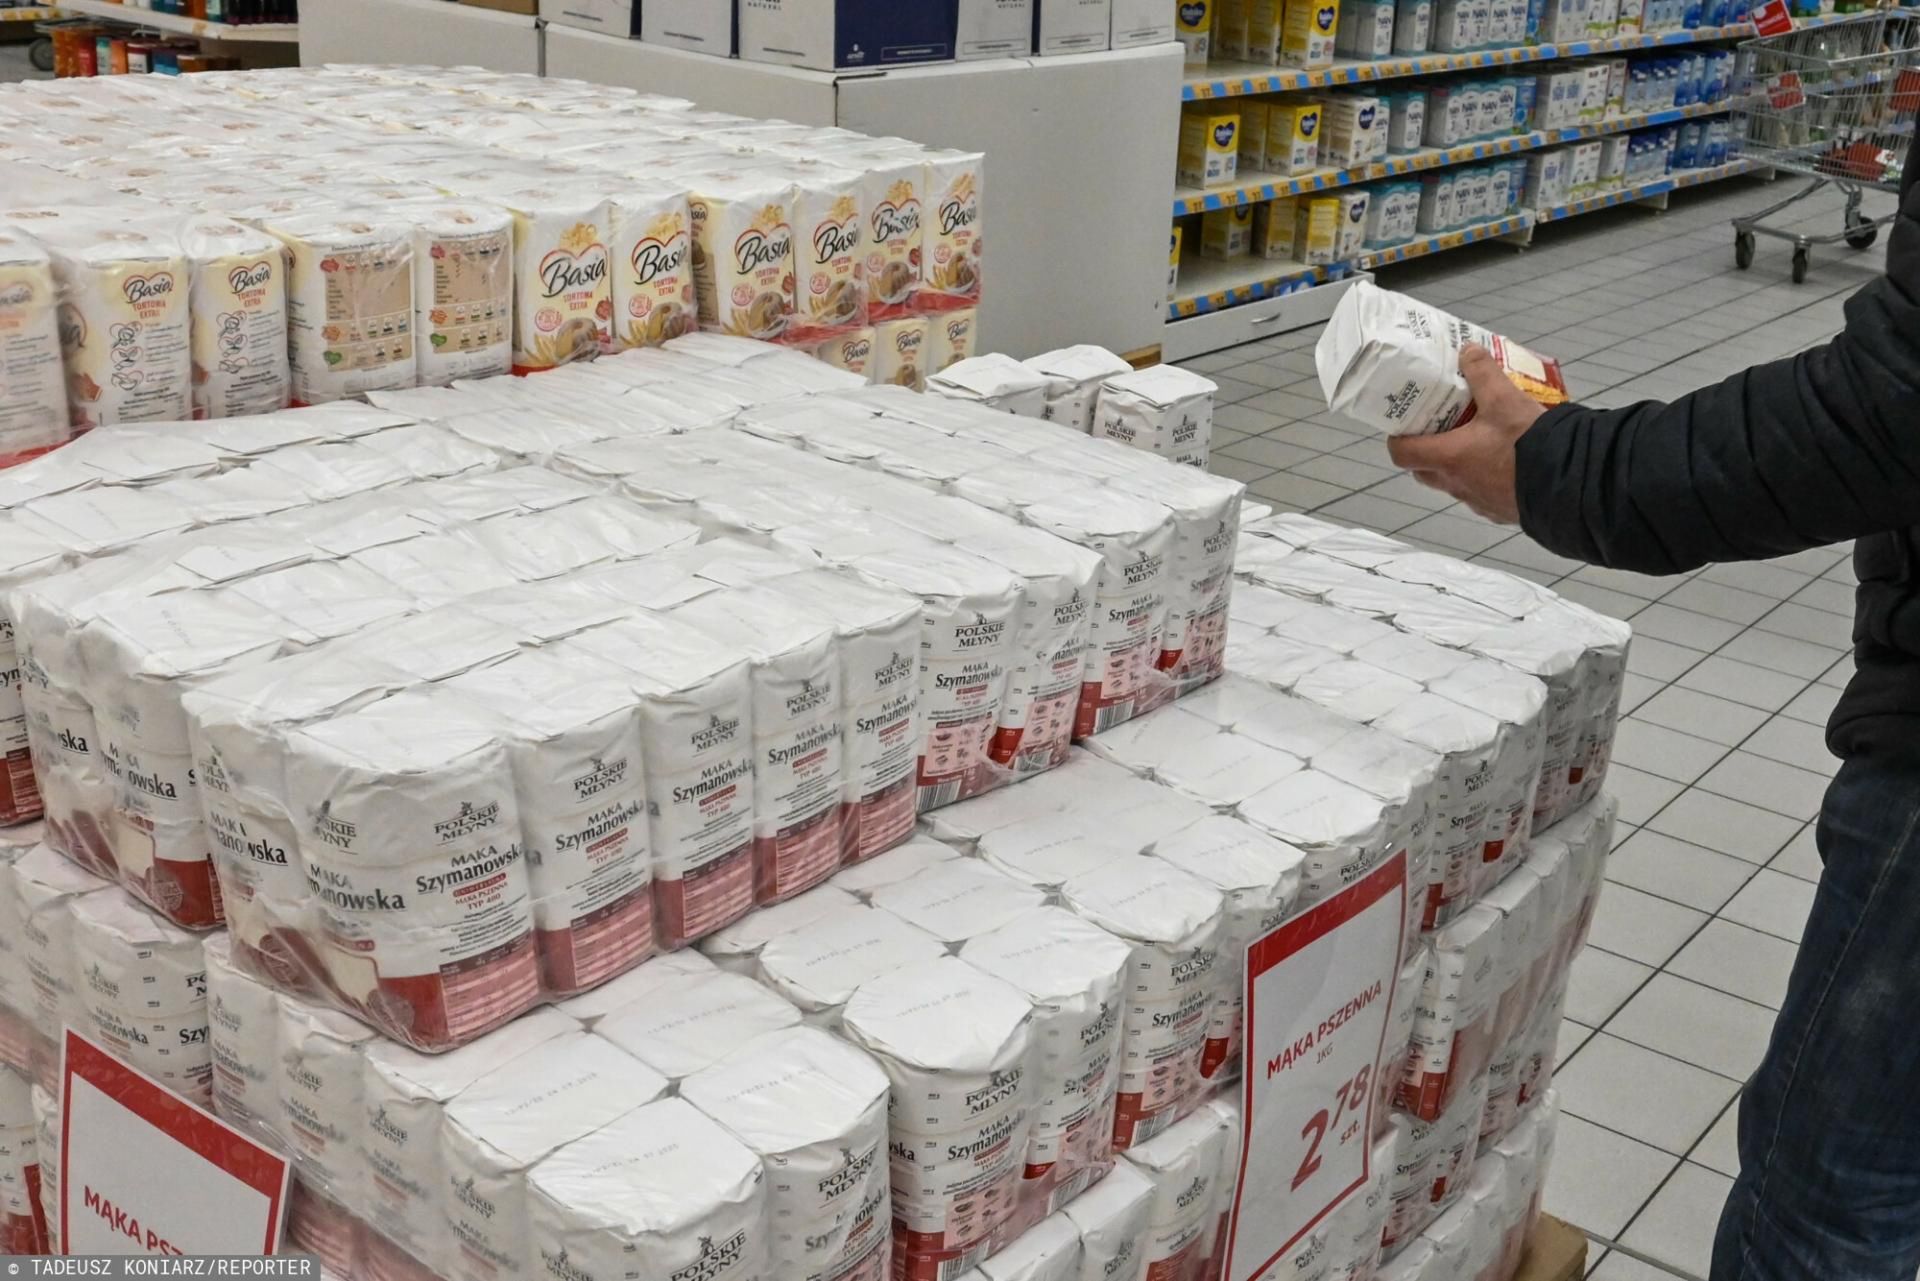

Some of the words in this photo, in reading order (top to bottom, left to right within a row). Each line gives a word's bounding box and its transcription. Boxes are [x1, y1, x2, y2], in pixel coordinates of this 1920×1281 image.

[737, 232, 792, 275] Basia
[125, 278, 173, 304] Basia
[231, 267, 271, 293] Basia
[541, 254, 608, 298] Basia
[954, 621, 1006, 638] POLSKIE
[958, 634, 1002, 648] MŁYNY
[691, 717, 740, 745] POLSKIE
[696, 729, 737, 753] MŁYNY
[574, 758, 627, 791] POLSKIE
[580, 770, 625, 799] MŁYNY
[434, 801, 500, 834] POLSKIE
[442, 813, 498, 842] MŁYNY
[306, 874, 406, 911] manowska
[1266, 1030, 1315, 1080] MĄKA
[1316, 979, 1382, 1044] PSZENNA
[1316, 1042, 1333, 1065] 1KG
[965, 1067, 1025, 1107] POLSKIE
[970, 1081, 1020, 1115] MŁYNY
[1339, 1119, 1361, 1146] szt.
[83, 1185, 142, 1245] MĄKA
[670, 1231, 748, 1281] POLSKIE
